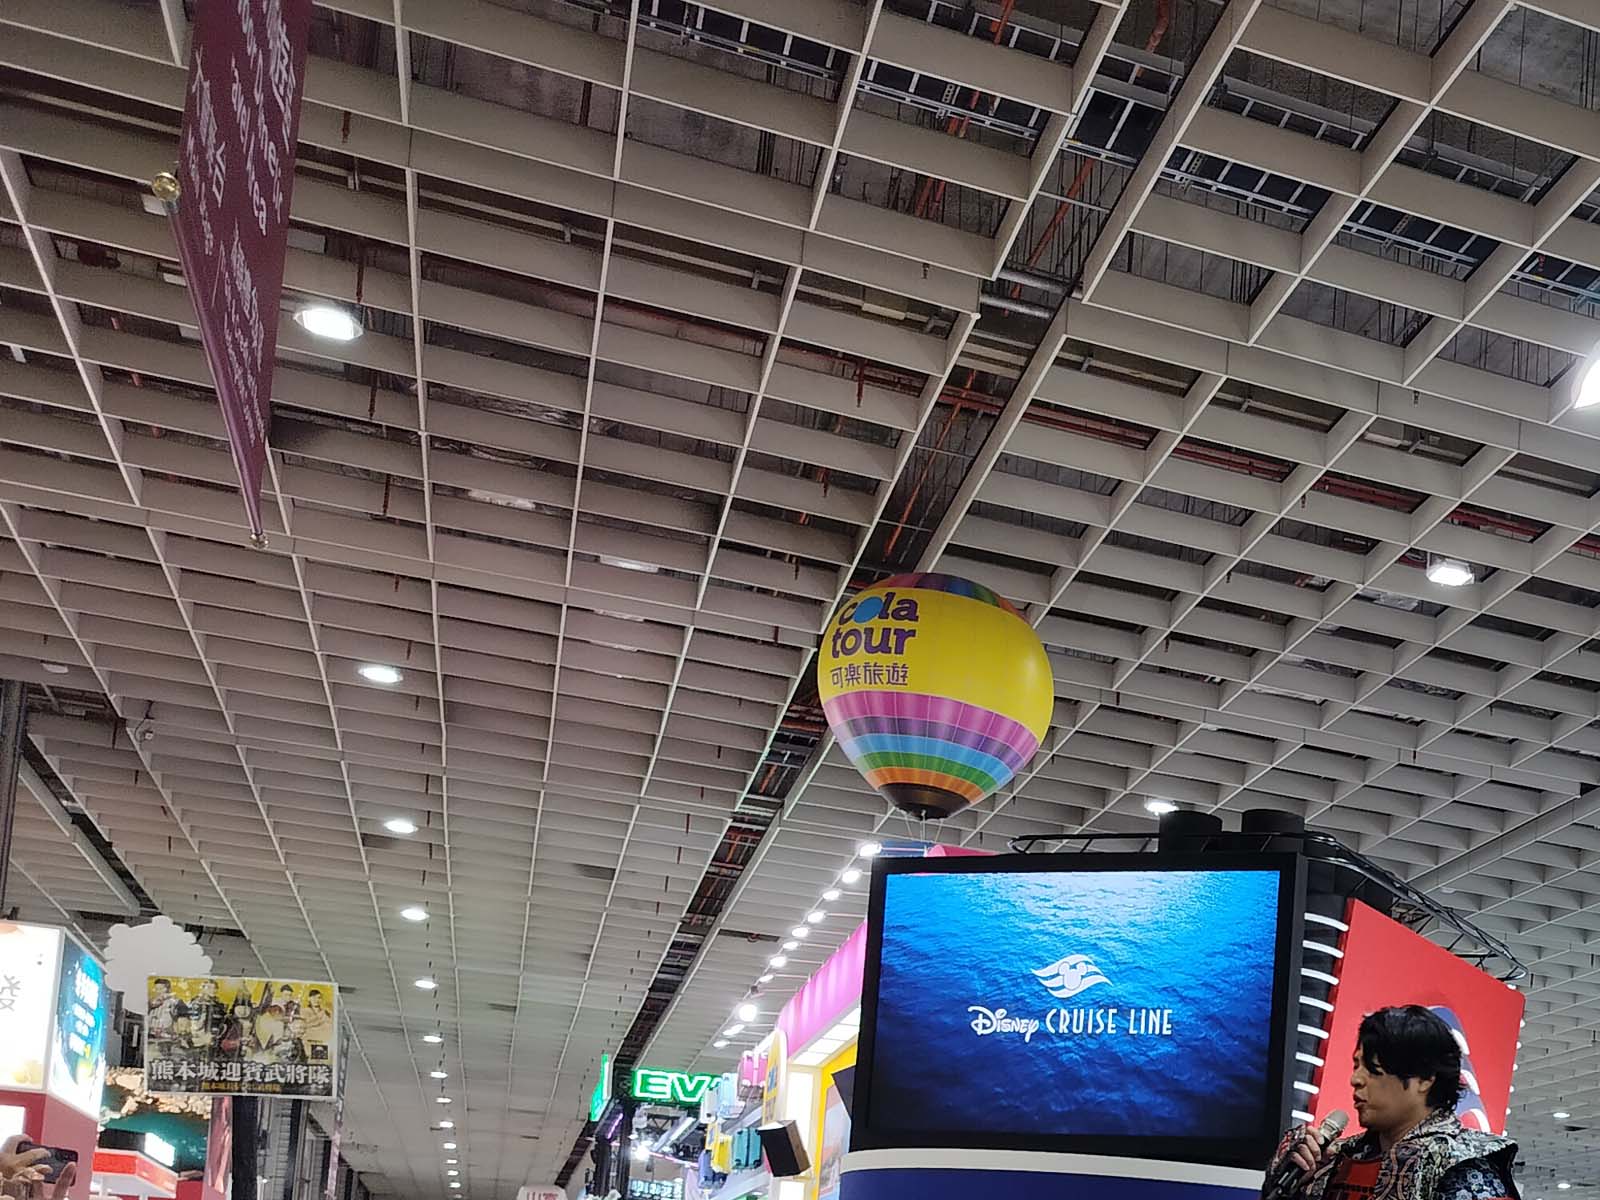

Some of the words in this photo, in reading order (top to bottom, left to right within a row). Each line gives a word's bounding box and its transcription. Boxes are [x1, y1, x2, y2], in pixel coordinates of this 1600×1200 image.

[838, 592, 918, 626] cola
[831, 627, 916, 659] tour
[967, 1005, 1040, 1044] Disney
[1045, 1008, 1117, 1035] CRUISE
[1129, 1009, 1174, 1035] LINE
[151, 1060, 331, 1085] 熊本城迎賓武將隊
[634, 1069, 723, 1103] EV
